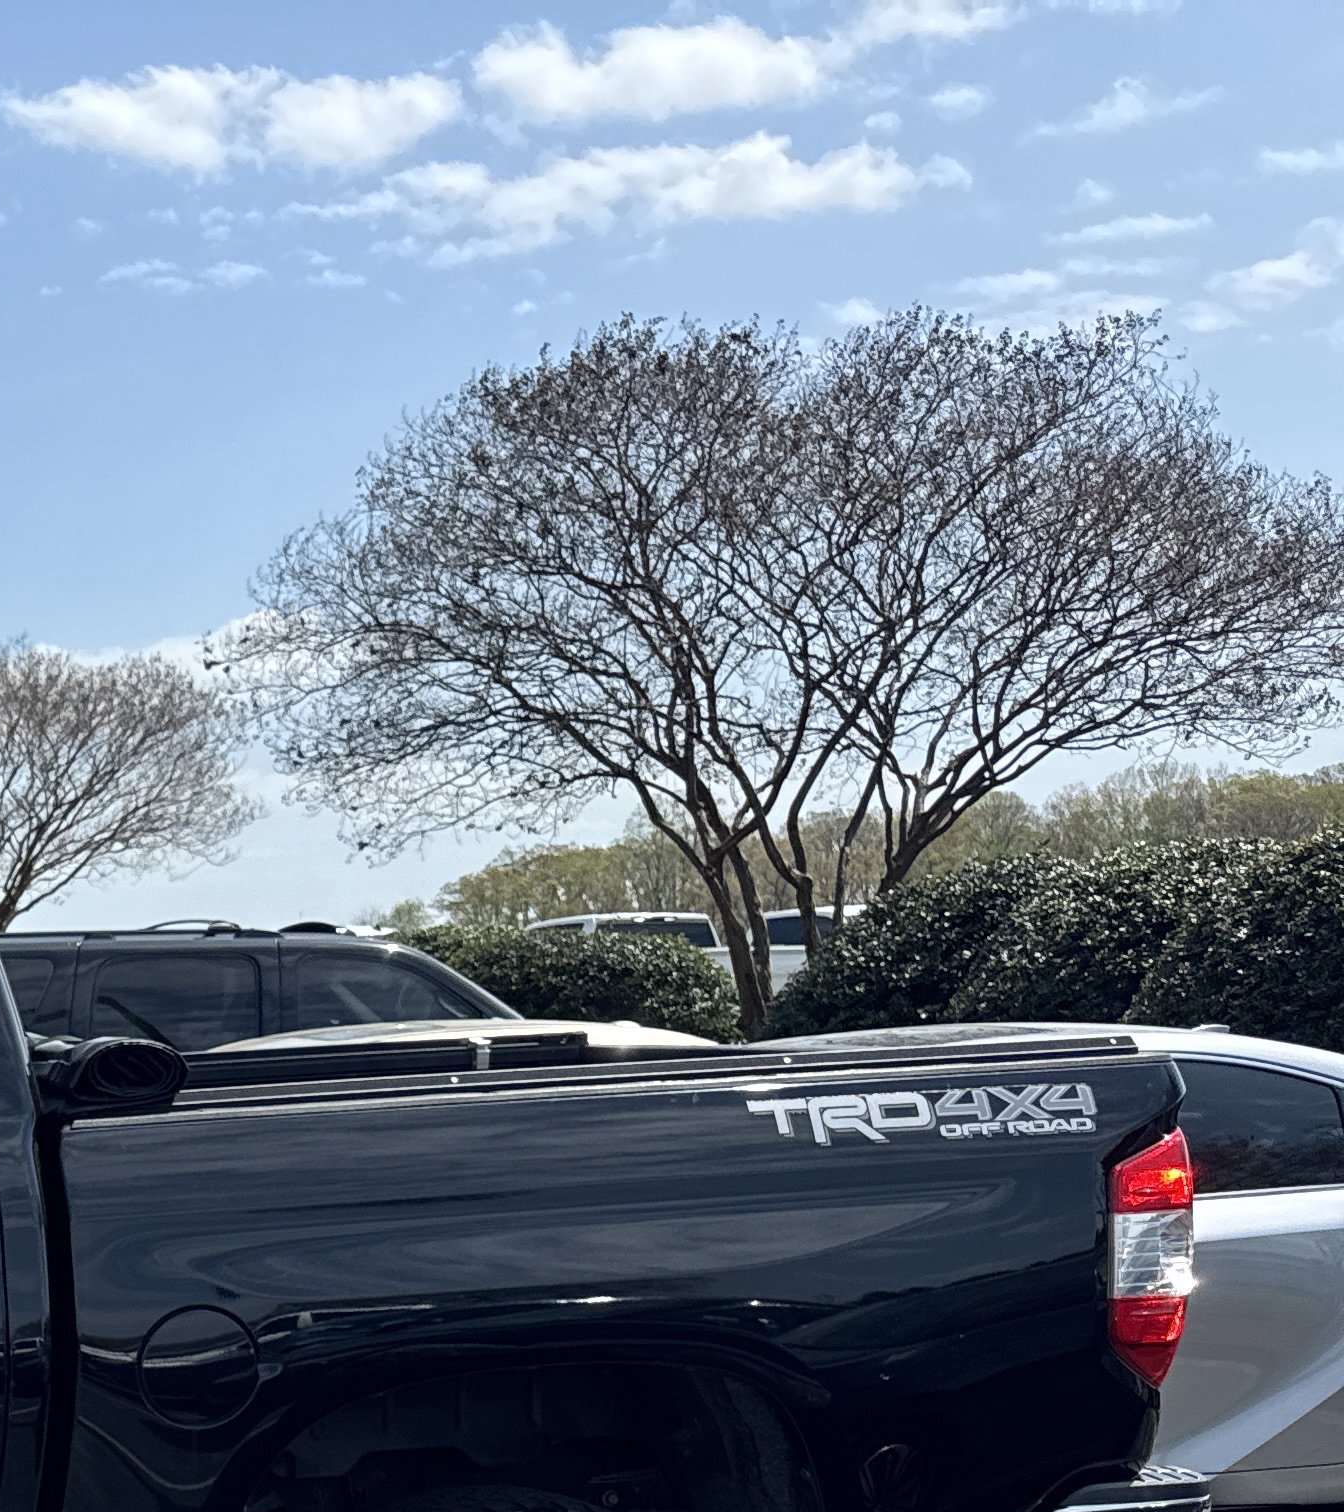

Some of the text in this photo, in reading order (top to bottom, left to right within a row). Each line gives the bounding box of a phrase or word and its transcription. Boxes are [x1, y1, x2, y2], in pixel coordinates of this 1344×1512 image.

[746, 1083, 1098, 1146] TRD 4X4
[939, 1117, 1097, 1140] OFF ROAD
